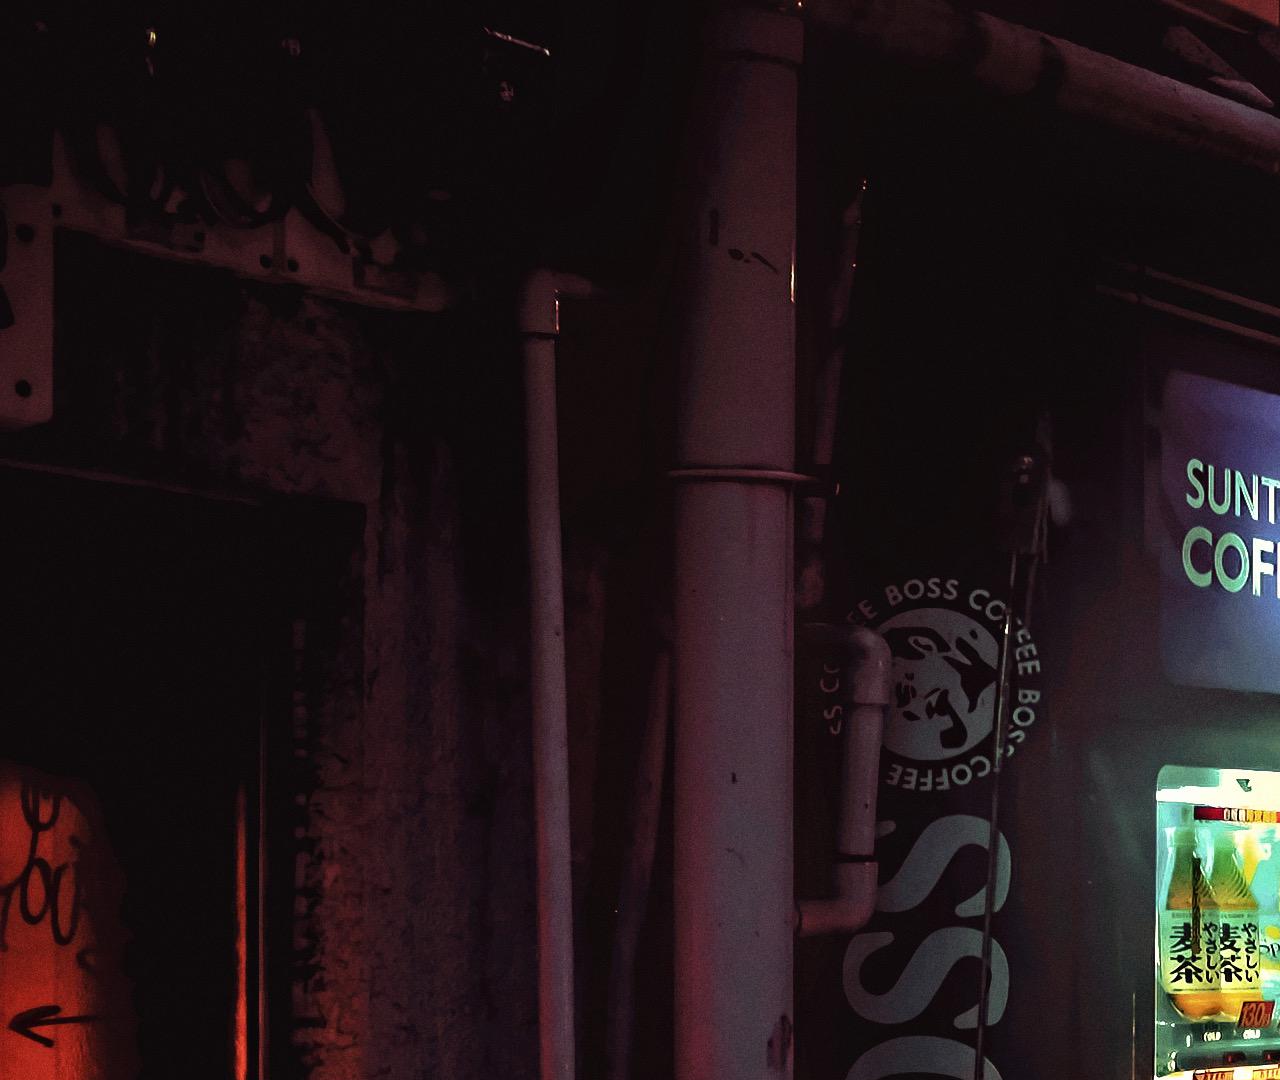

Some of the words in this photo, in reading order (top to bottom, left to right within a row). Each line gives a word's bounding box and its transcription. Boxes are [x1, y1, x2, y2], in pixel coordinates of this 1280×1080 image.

[884, 576, 959, 608] BOSS
[886, 753, 991, 791] COFFEE
[1170, 922, 1203, 984] 麦茶
[1203, 922, 1219, 984] やさしい
[1220, 922, 1243, 984] 麦茶
[1242, 922, 1260, 984] やさしい
